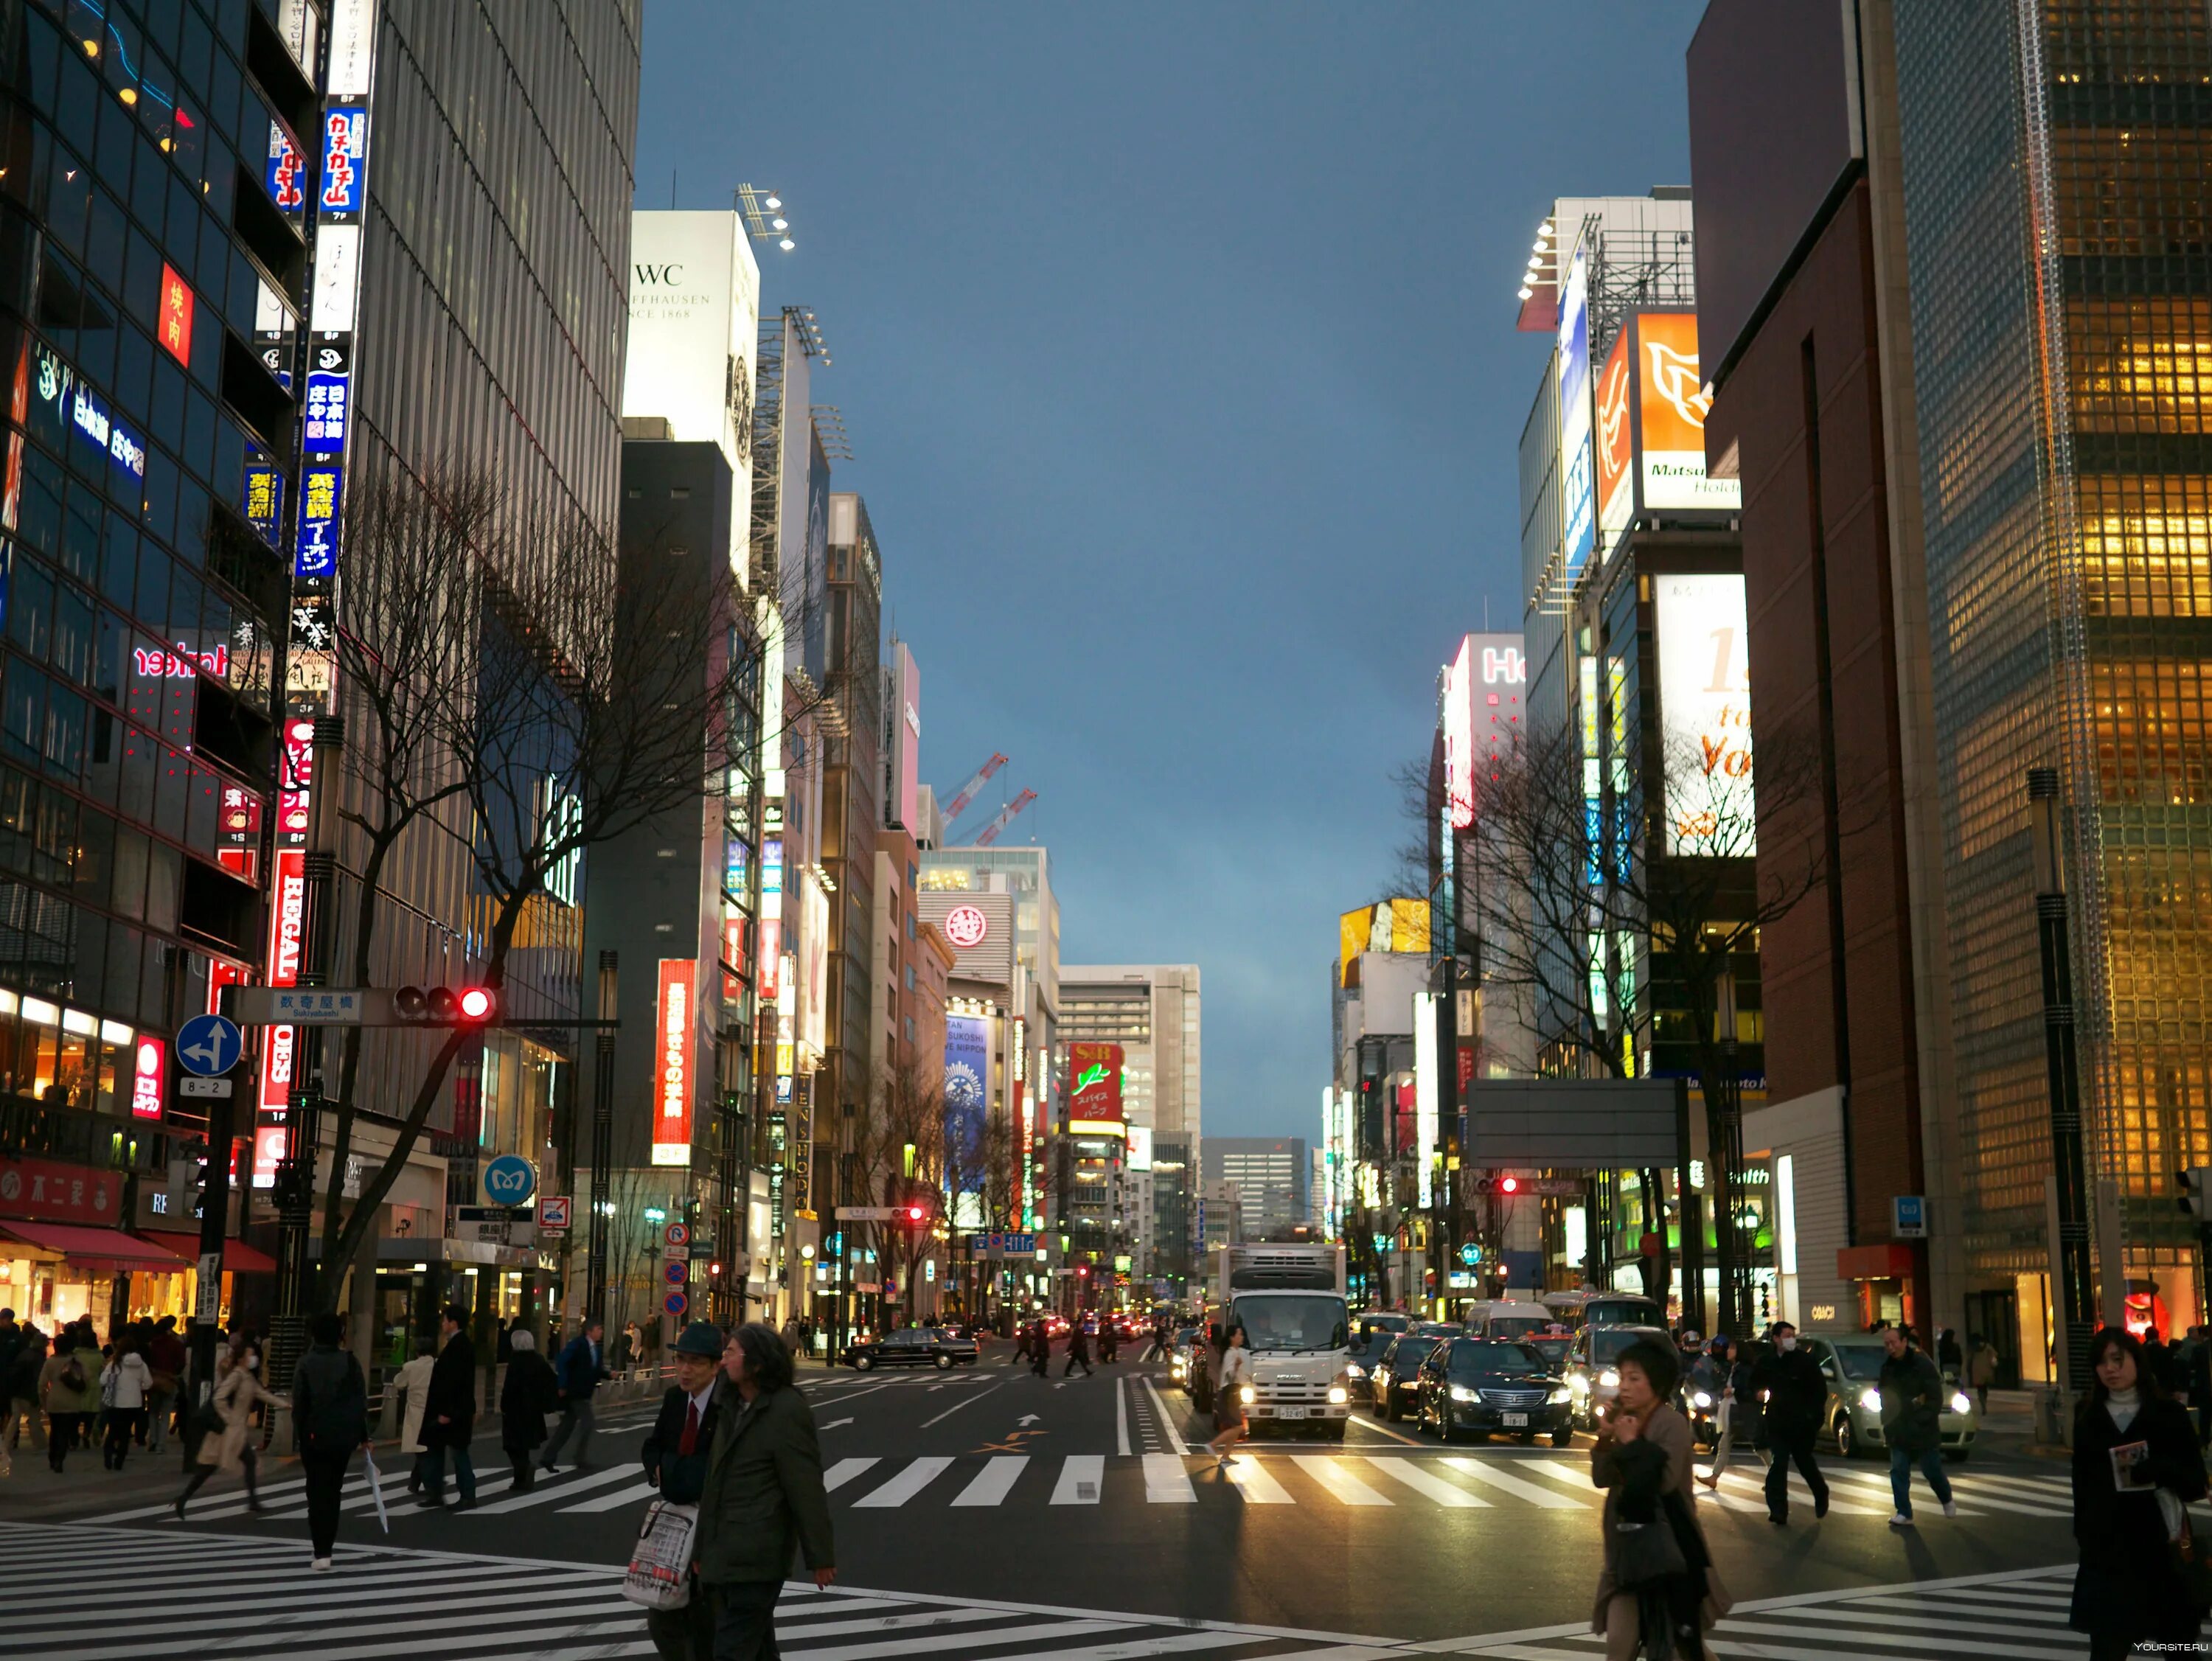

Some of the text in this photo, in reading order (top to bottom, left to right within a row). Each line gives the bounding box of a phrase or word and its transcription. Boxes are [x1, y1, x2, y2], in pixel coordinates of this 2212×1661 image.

[324, 114, 354, 206] カチカチ山
[169, 281, 184, 350] 焼肉
[662, 309, 690, 318] 1868
[278, 874, 305, 978] REGAL
[280, 995, 352, 1009] 数寄屋橋
[293, 1009, 339, 1017] Sukiyabashi
